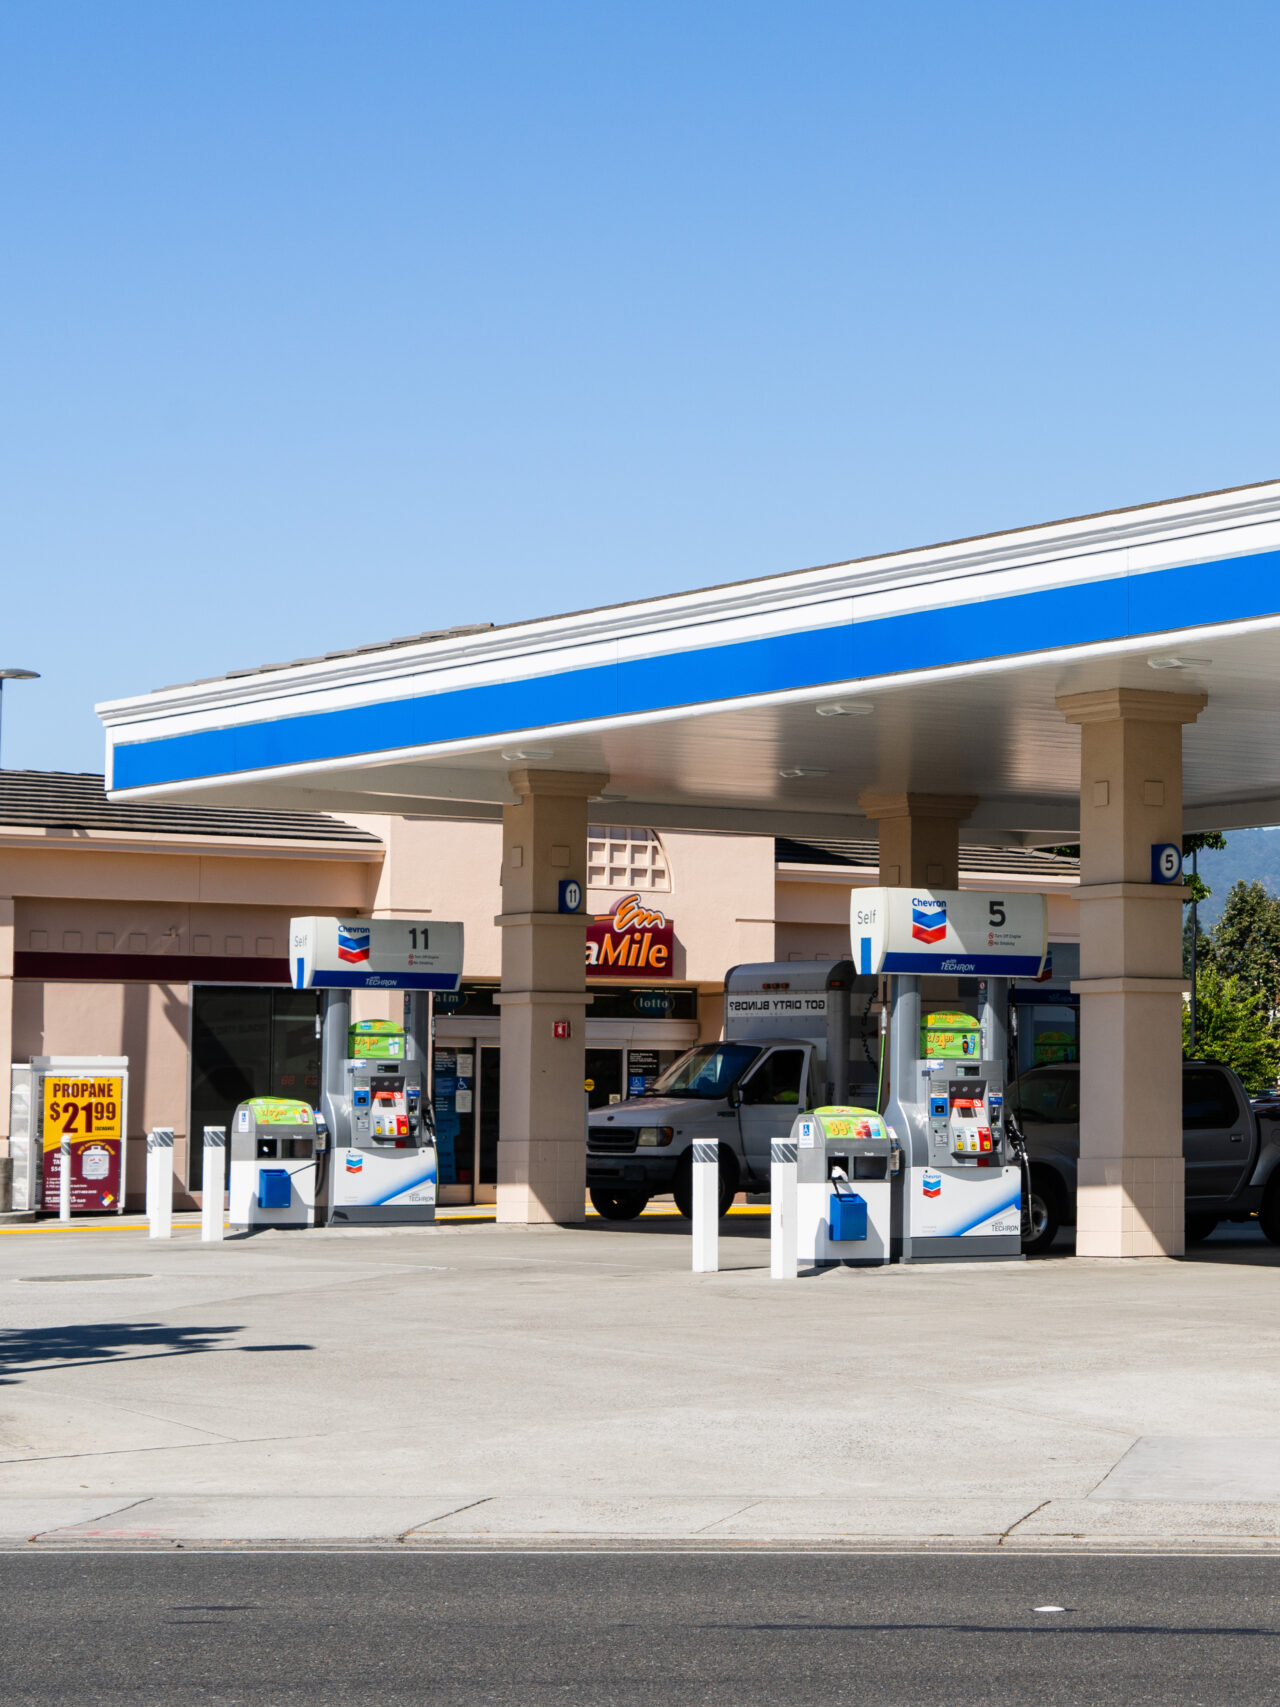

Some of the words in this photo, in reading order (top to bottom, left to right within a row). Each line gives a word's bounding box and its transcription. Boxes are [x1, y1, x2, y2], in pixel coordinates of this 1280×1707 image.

[1165, 854, 1174, 871] 5
[569, 888, 577, 903] 11
[912, 897, 947, 908] Chevron
[857, 909, 877, 925] Self
[988, 900, 1006, 927] 5
[337, 925, 370, 934] Chevron
[294, 934, 308, 948] Self
[408, 928, 429, 950] 11
[940, 962, 976, 972] TECHRON
[365, 978, 397, 987] TECHRON
[640, 998, 669, 1008] lotto
[53, 1083, 113, 1098] PROPANE
[991, 1225, 1019, 1233] TECHRON
